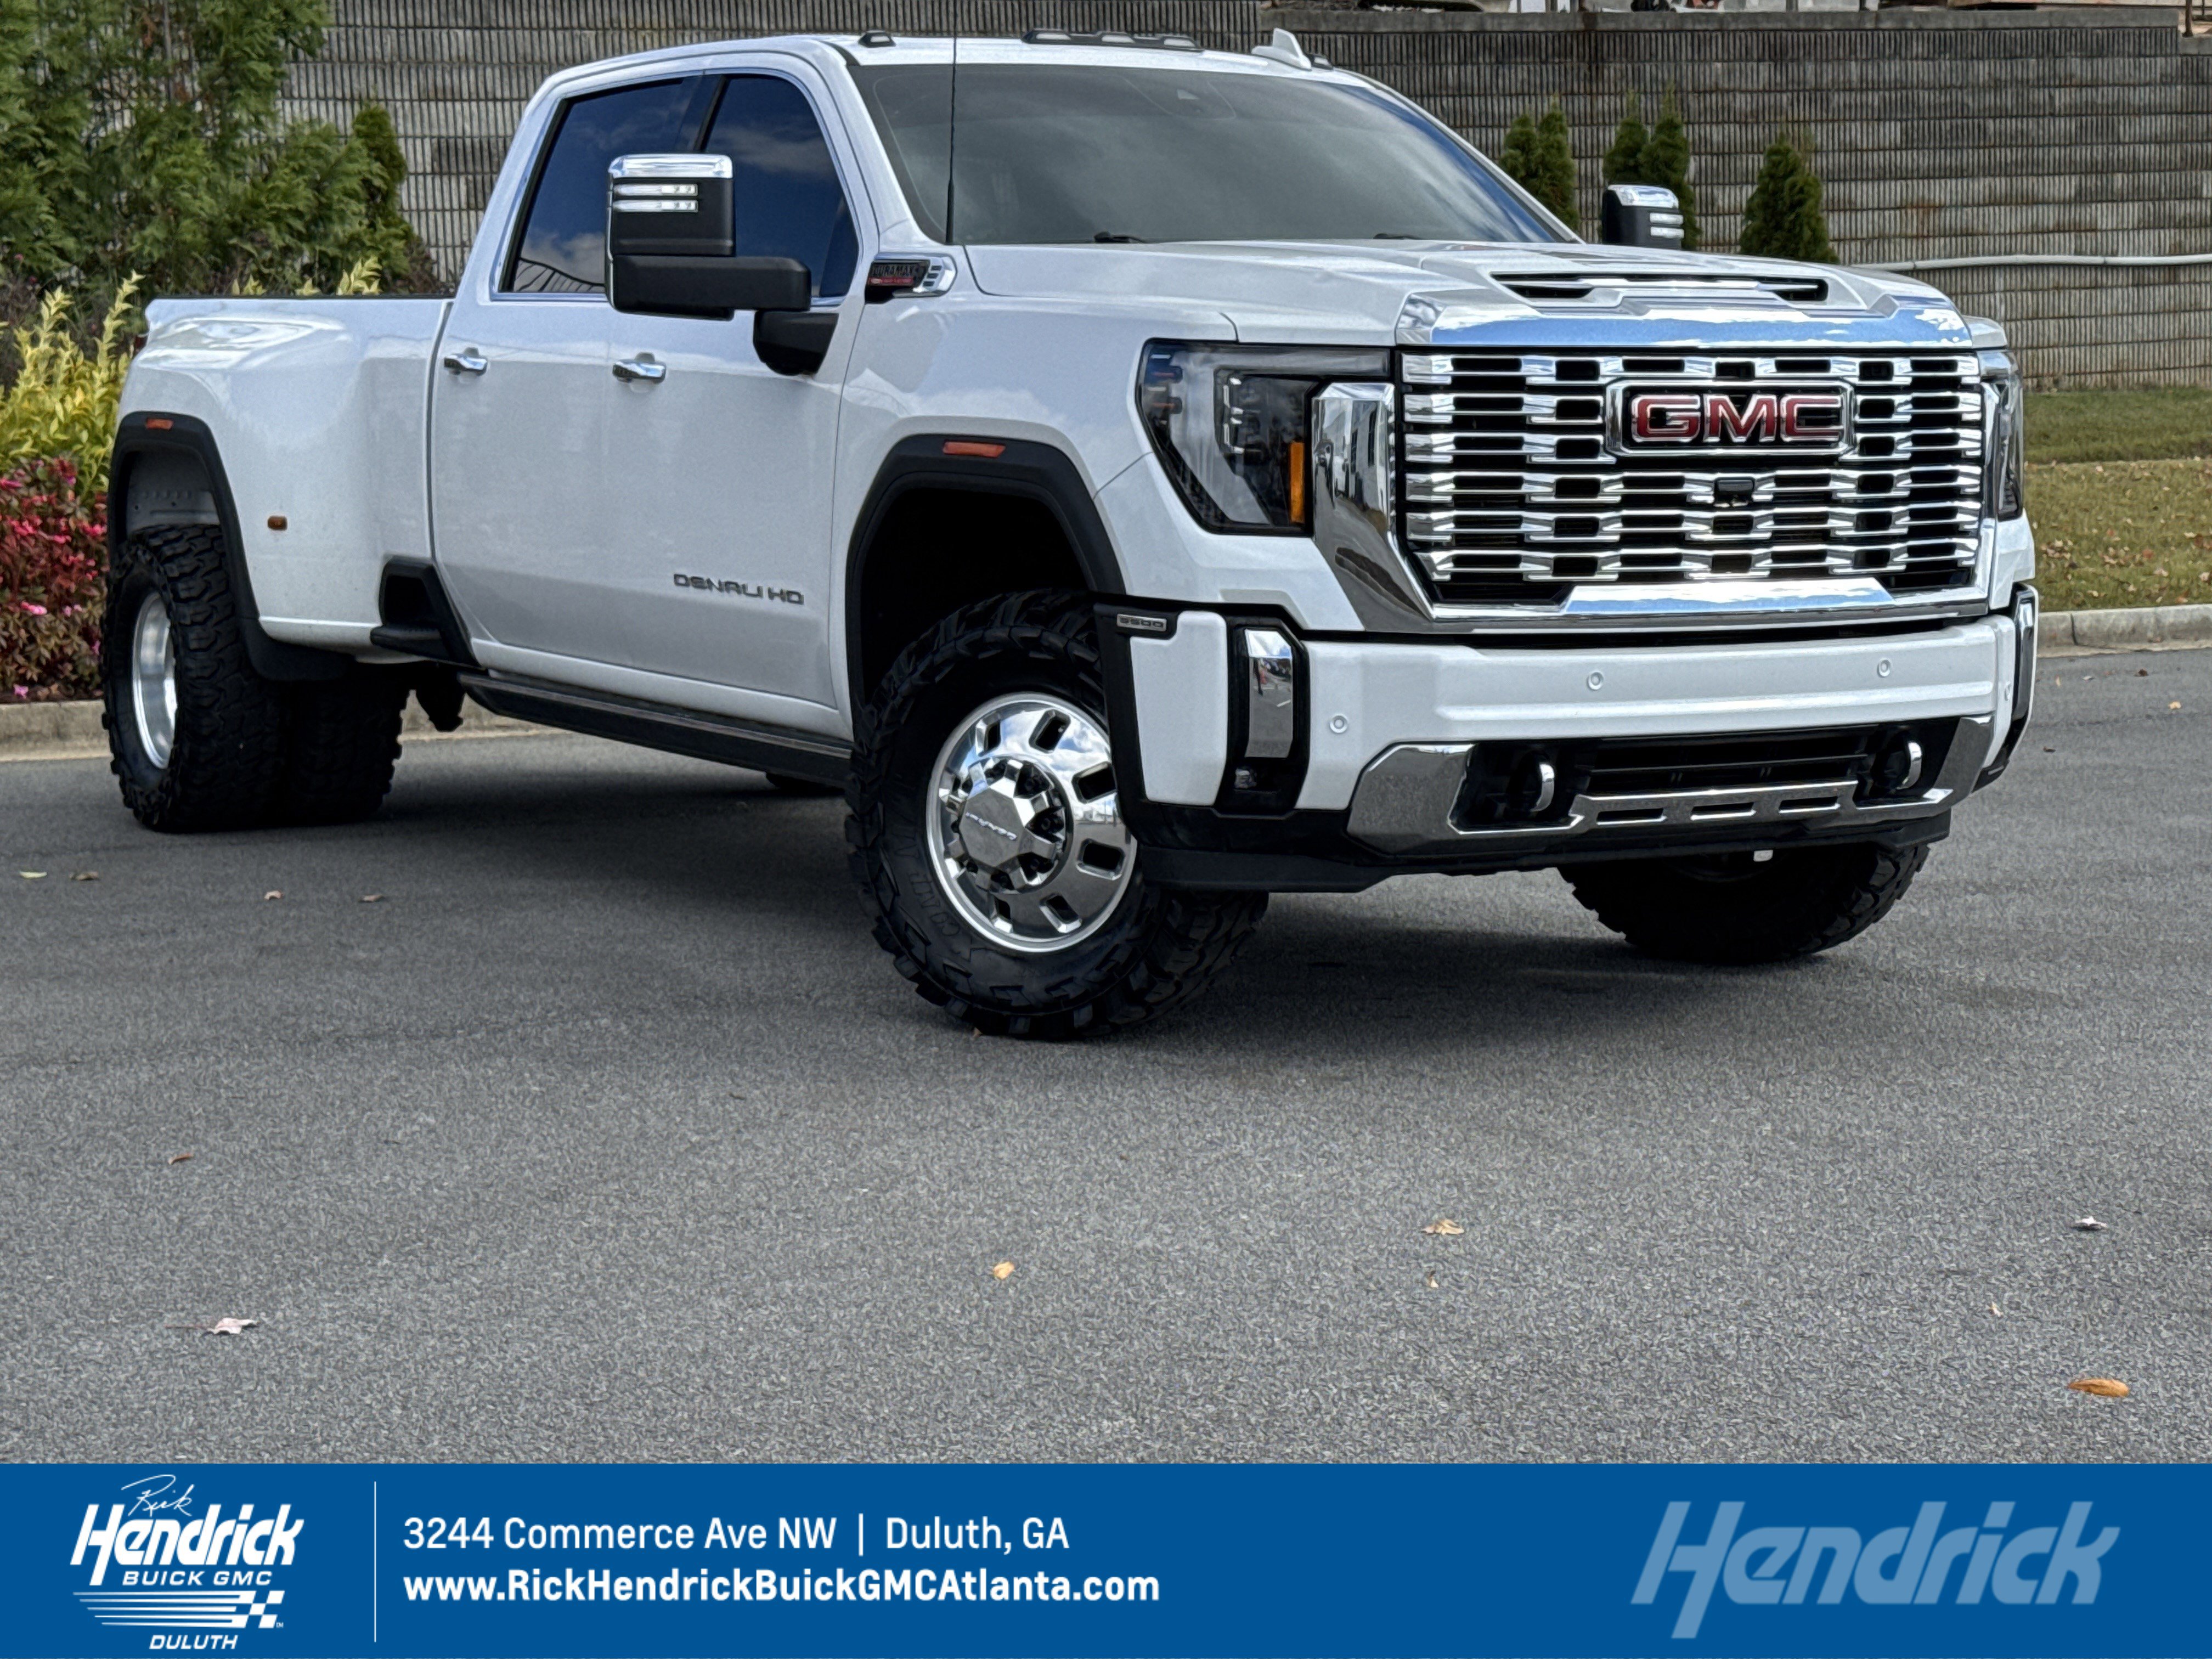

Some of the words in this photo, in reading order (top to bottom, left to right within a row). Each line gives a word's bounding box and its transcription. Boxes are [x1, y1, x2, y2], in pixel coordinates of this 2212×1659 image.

[872, 263, 913, 277] DURAMAX
[1631, 394, 1843, 442] GMC
[673, 573, 764, 599] DENALI
[768, 586, 805, 605] HD
